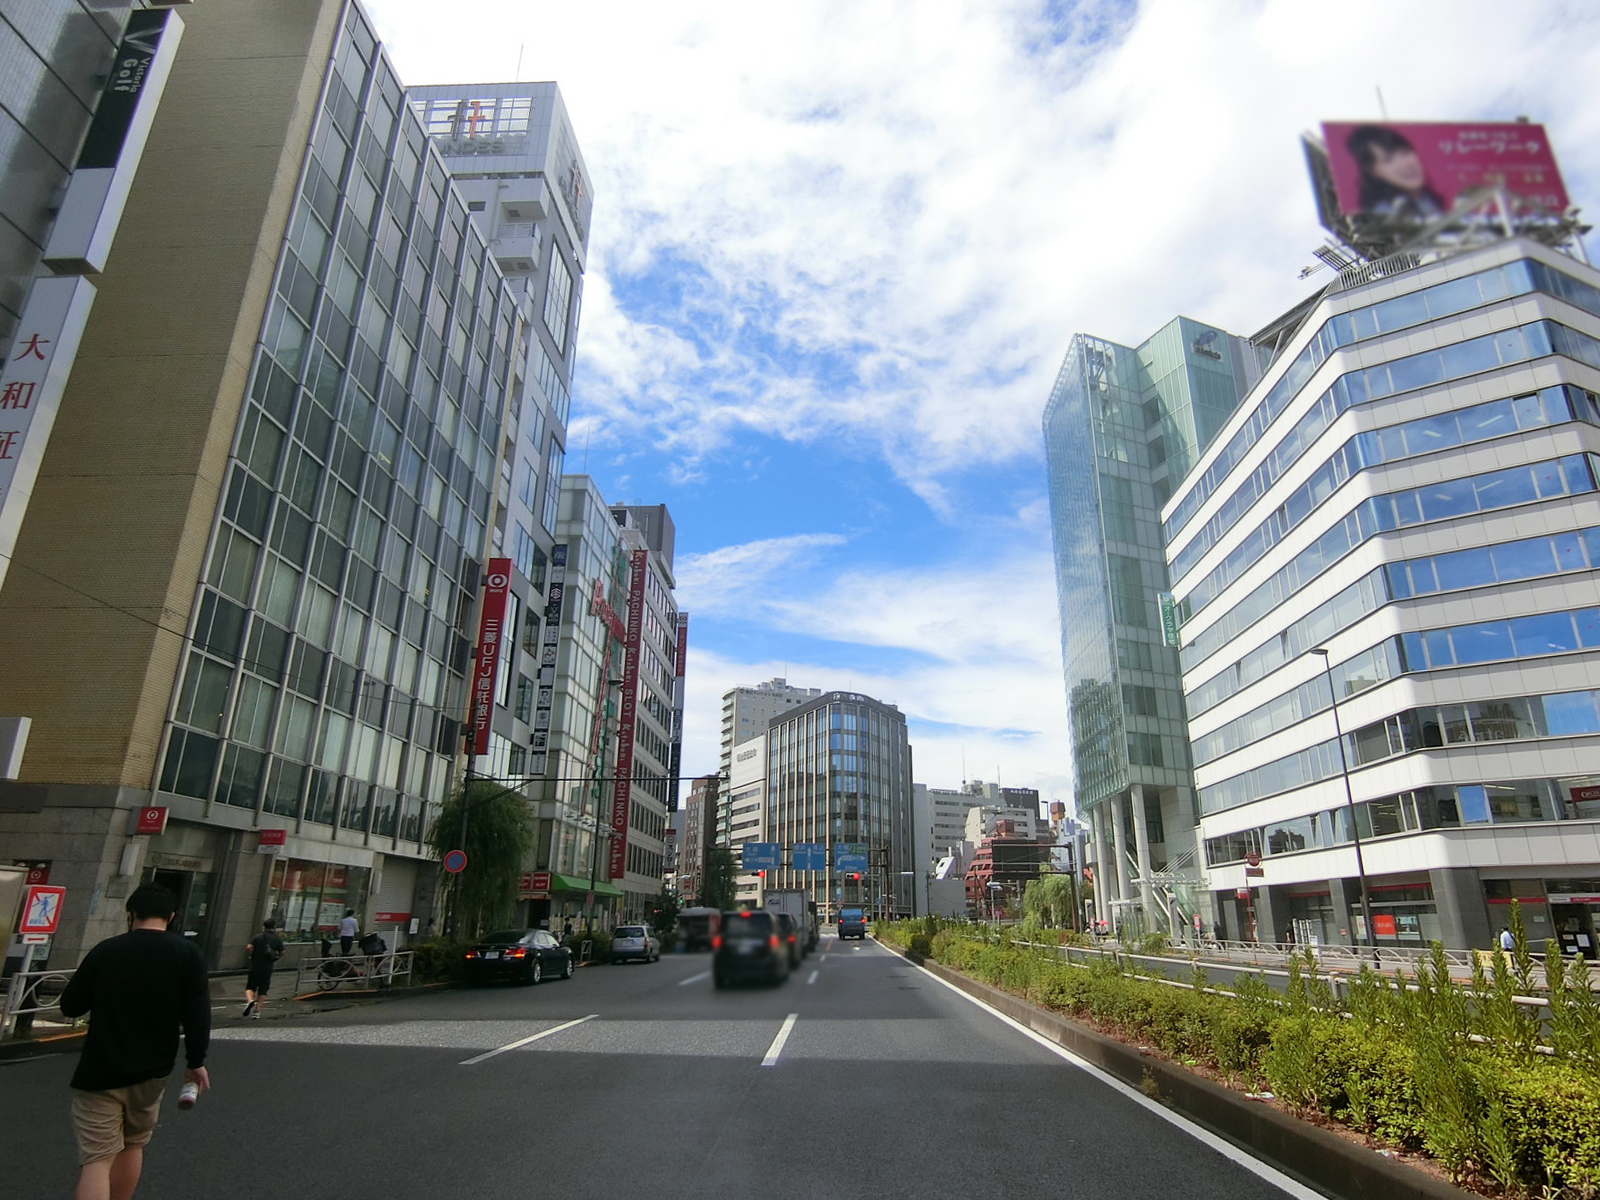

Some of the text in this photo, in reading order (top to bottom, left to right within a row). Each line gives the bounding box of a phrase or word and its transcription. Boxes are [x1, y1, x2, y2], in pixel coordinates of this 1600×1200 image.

[114, 58, 139, 91] Golf
[130, 57, 151, 93] Victoria
[629, 590, 641, 642] PACHINKO
[623, 689, 633, 718] SLOT
[615, 767, 627, 826] PACHINKO
